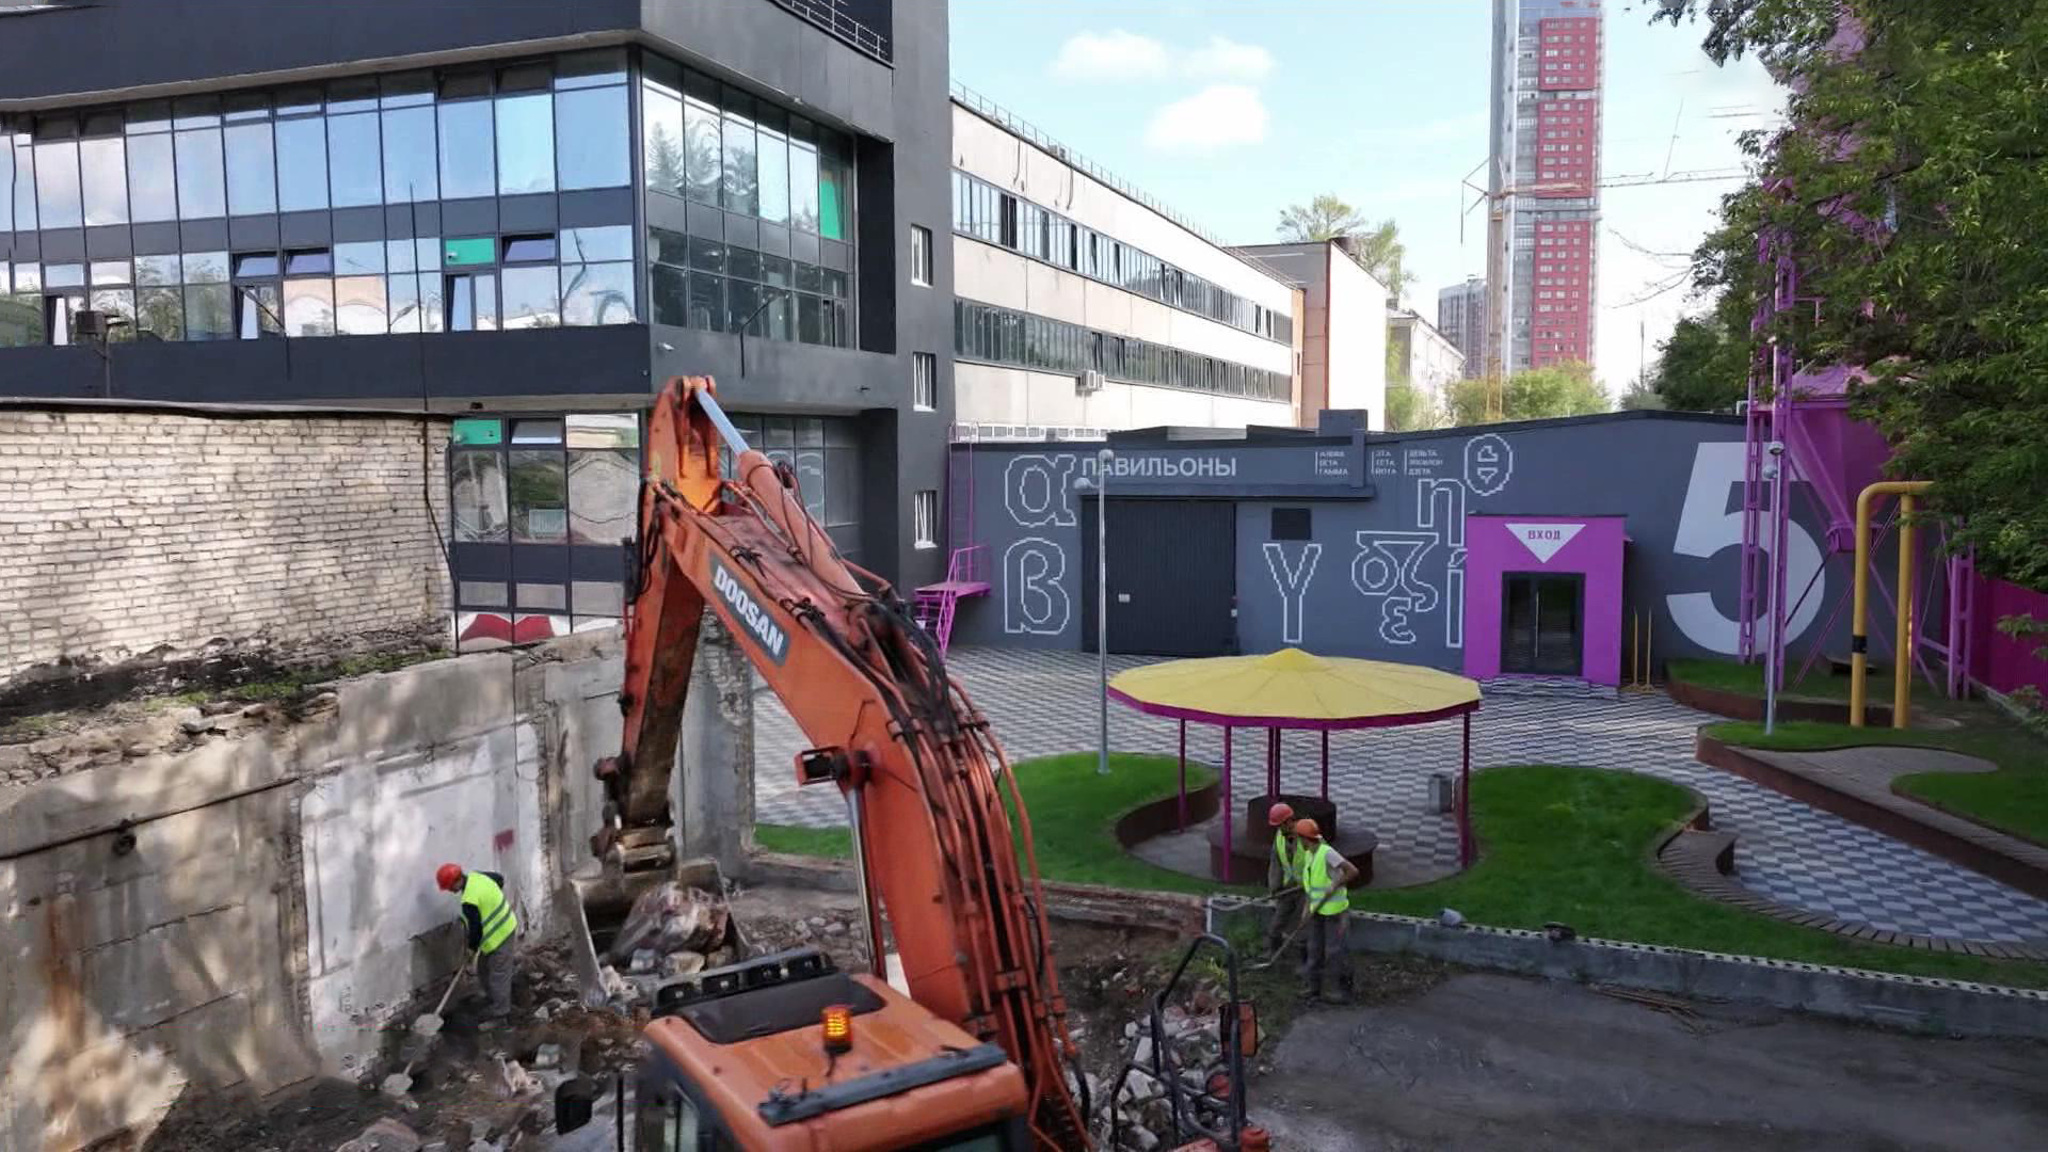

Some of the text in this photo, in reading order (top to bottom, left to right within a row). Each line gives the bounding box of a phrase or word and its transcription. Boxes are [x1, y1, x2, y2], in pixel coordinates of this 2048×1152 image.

[1082, 457, 1237, 477] ПАВИЛЬОНЫ
[1528, 529, 1561, 540] ВХОД
[1665, 441, 1826, 656] 5
[713, 565, 784, 656] DOOSAN
